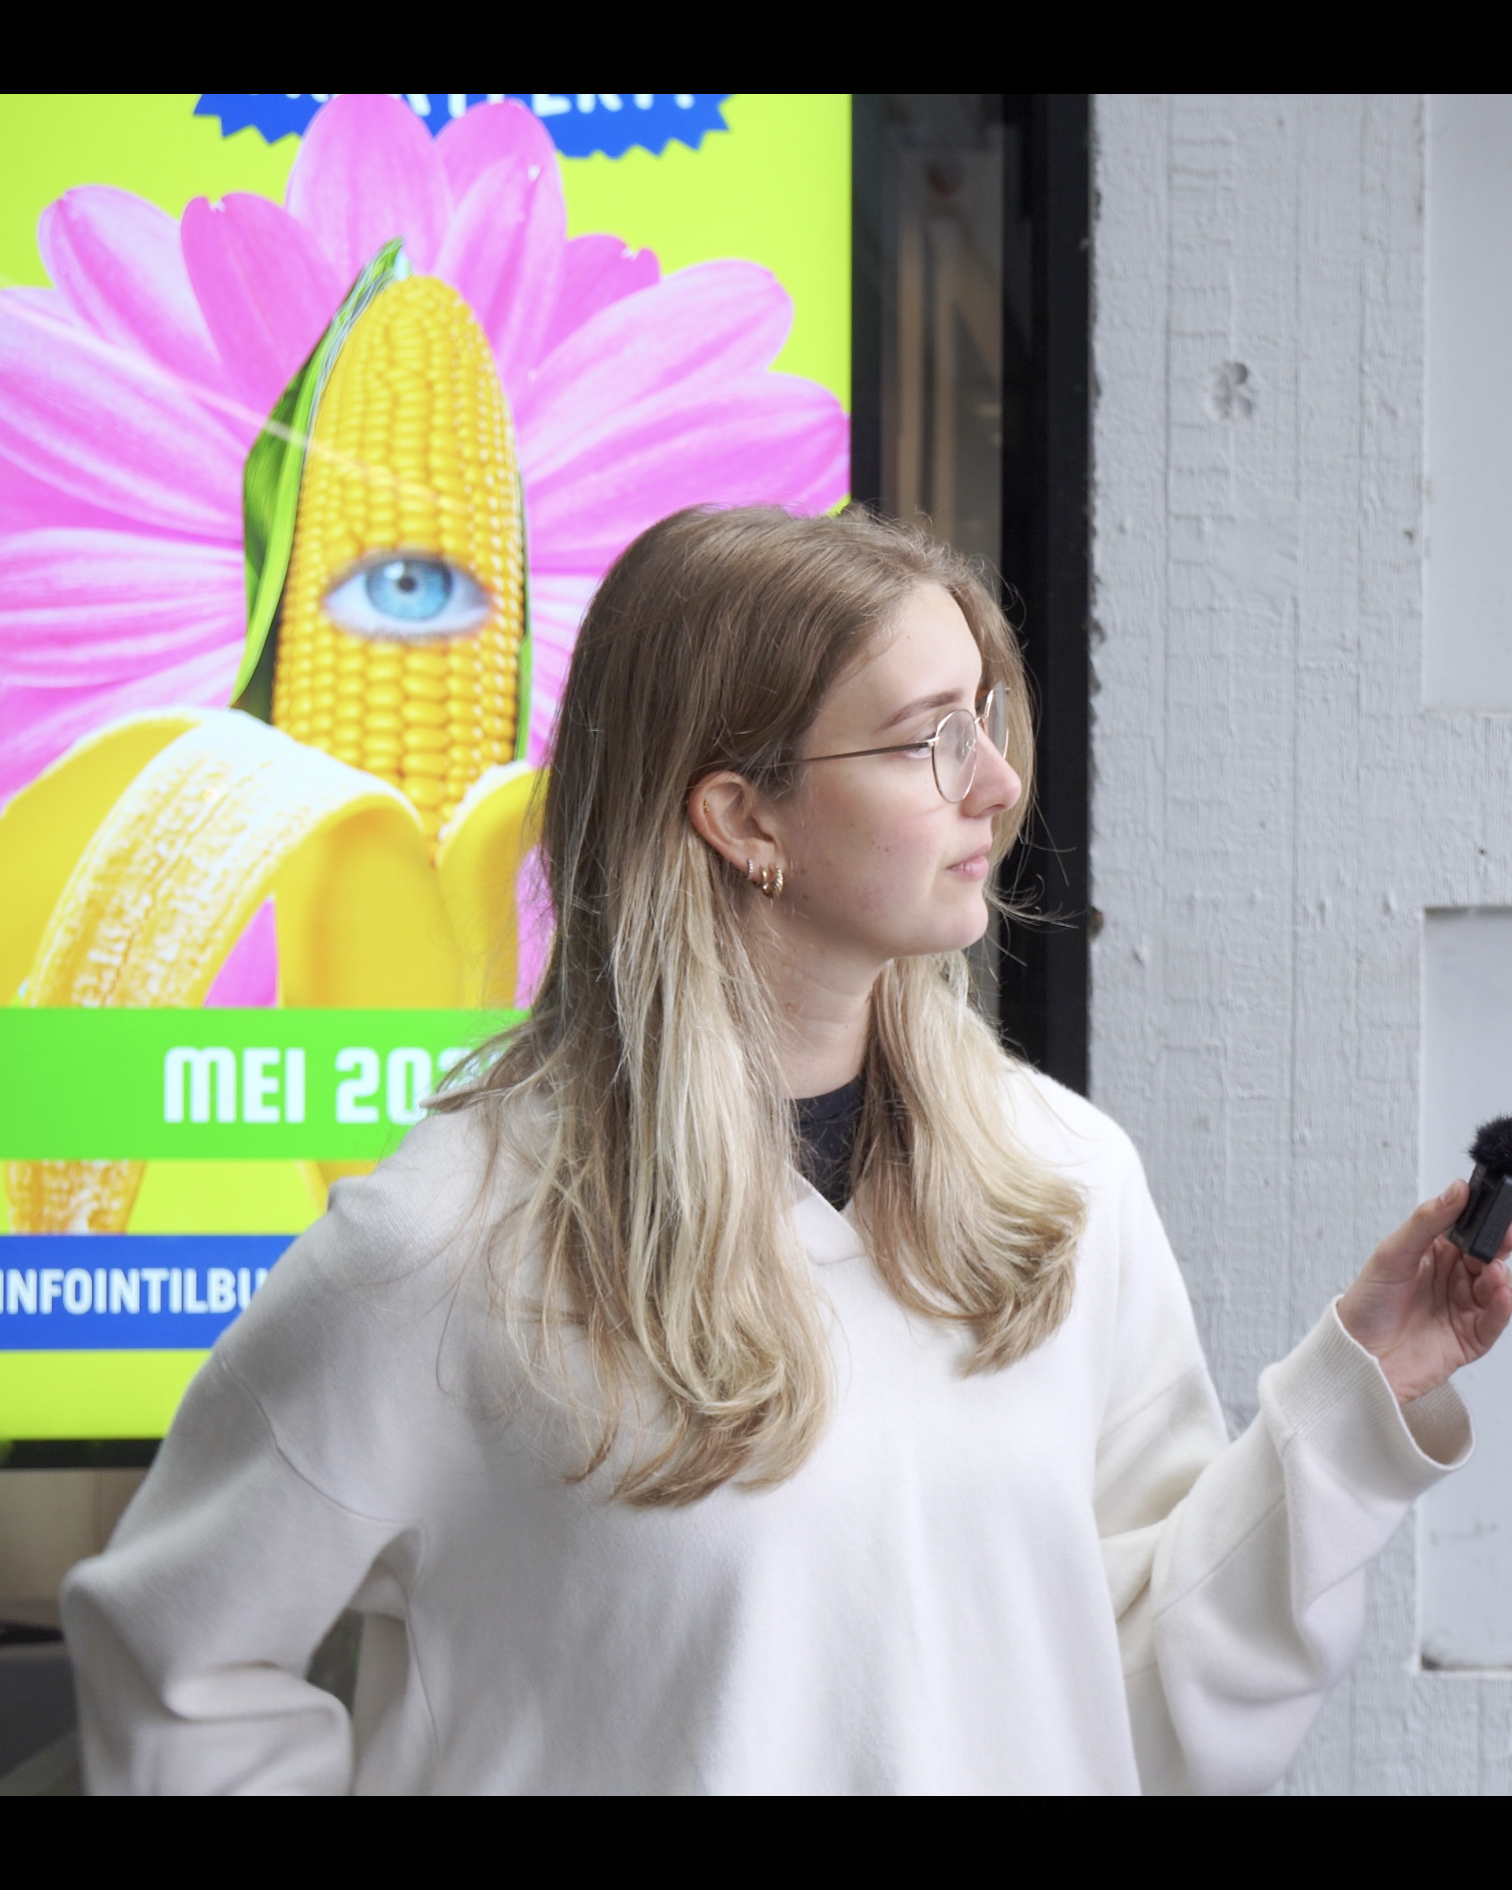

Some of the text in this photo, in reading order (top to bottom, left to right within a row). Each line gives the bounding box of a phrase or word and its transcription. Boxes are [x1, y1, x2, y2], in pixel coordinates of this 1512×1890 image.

[164, 1046, 505, 1125] MEI 20
[0, 1267, 271, 1315] NFOINTILBU
